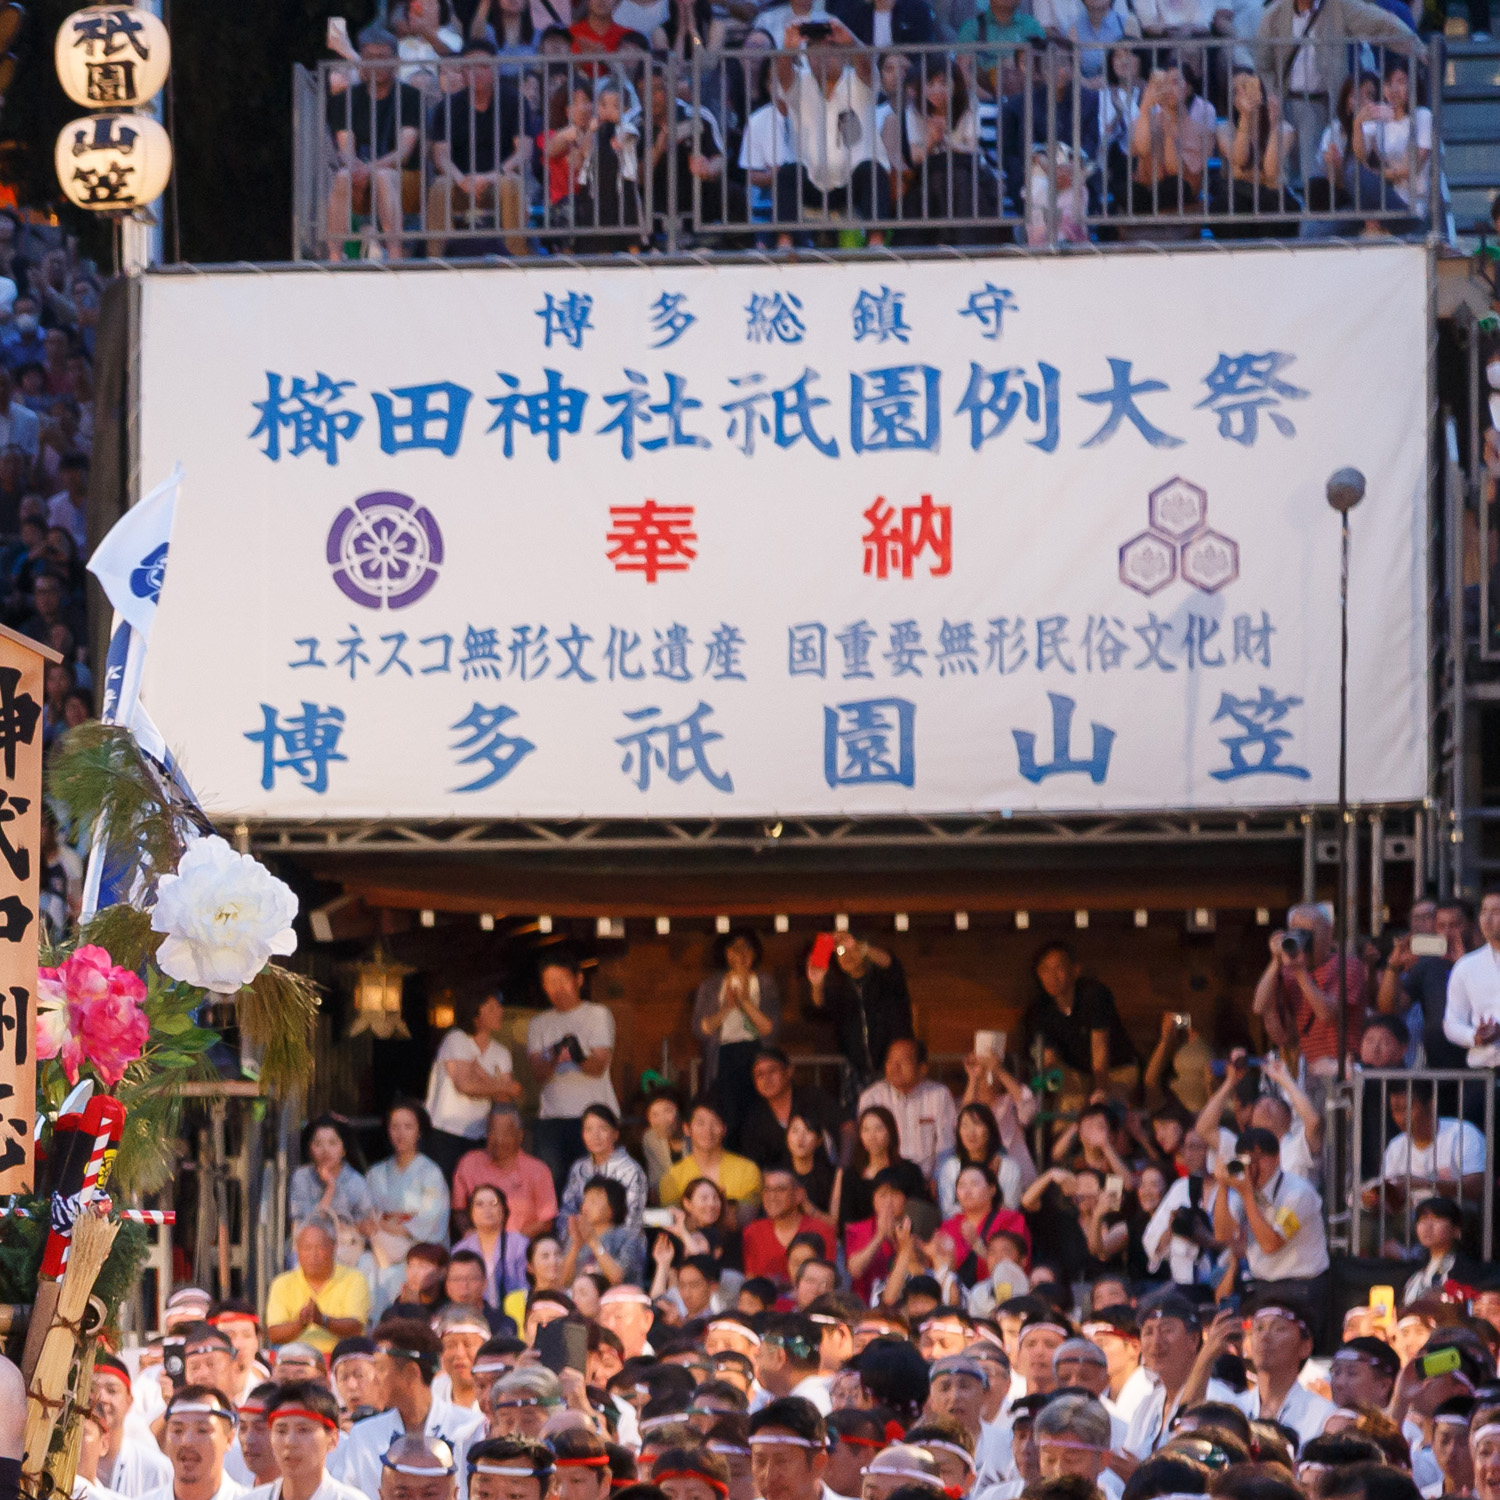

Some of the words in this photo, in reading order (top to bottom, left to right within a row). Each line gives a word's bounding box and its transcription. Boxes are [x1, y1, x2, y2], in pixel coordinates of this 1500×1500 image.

[73, 11, 150, 101] 祇園
[73, 118, 139, 204] 山笠
[535, 283, 1019, 349] 博多総鎮守
[248, 350, 1312, 466] 櫛田神社祇園例大祭
[605, 494, 953, 584] 奉納
[288, 622, 748, 683] ユネスコ無形文化遺産
[788, 612, 1276, 680] 国重要無形民俗文化財
[243, 688, 1312, 793] 博多祇園山笠
